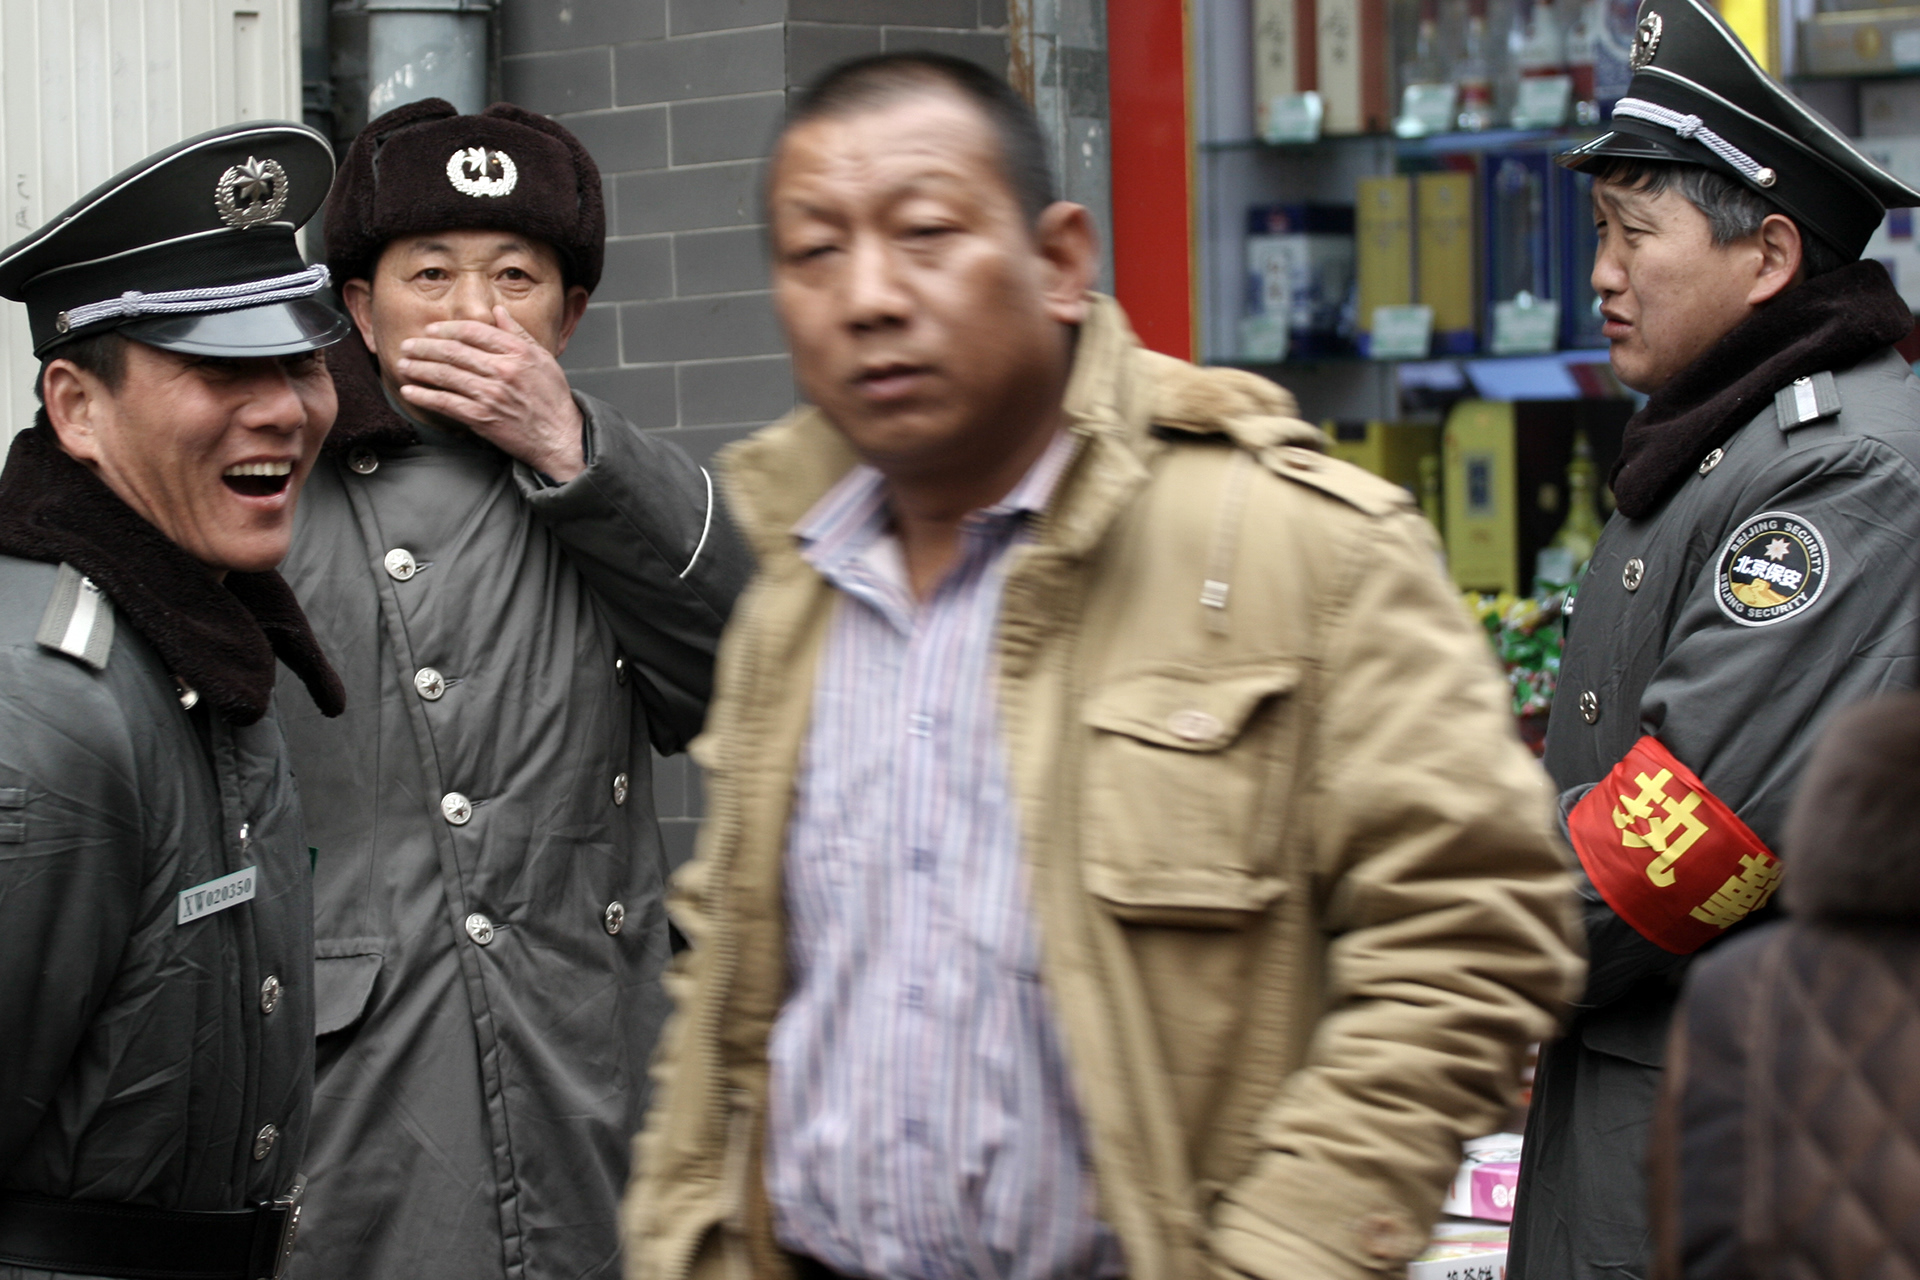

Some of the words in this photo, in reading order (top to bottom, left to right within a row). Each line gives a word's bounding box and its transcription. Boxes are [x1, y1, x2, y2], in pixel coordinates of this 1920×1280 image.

[1730, 520, 1778, 553] BEIJING
[1784, 522, 1823, 575] SECURITY
[1733, 555, 1803, 590] 北京保安
[1720, 573, 1745, 613] BEIJING
[1747, 591, 1809, 618] SECURITY
